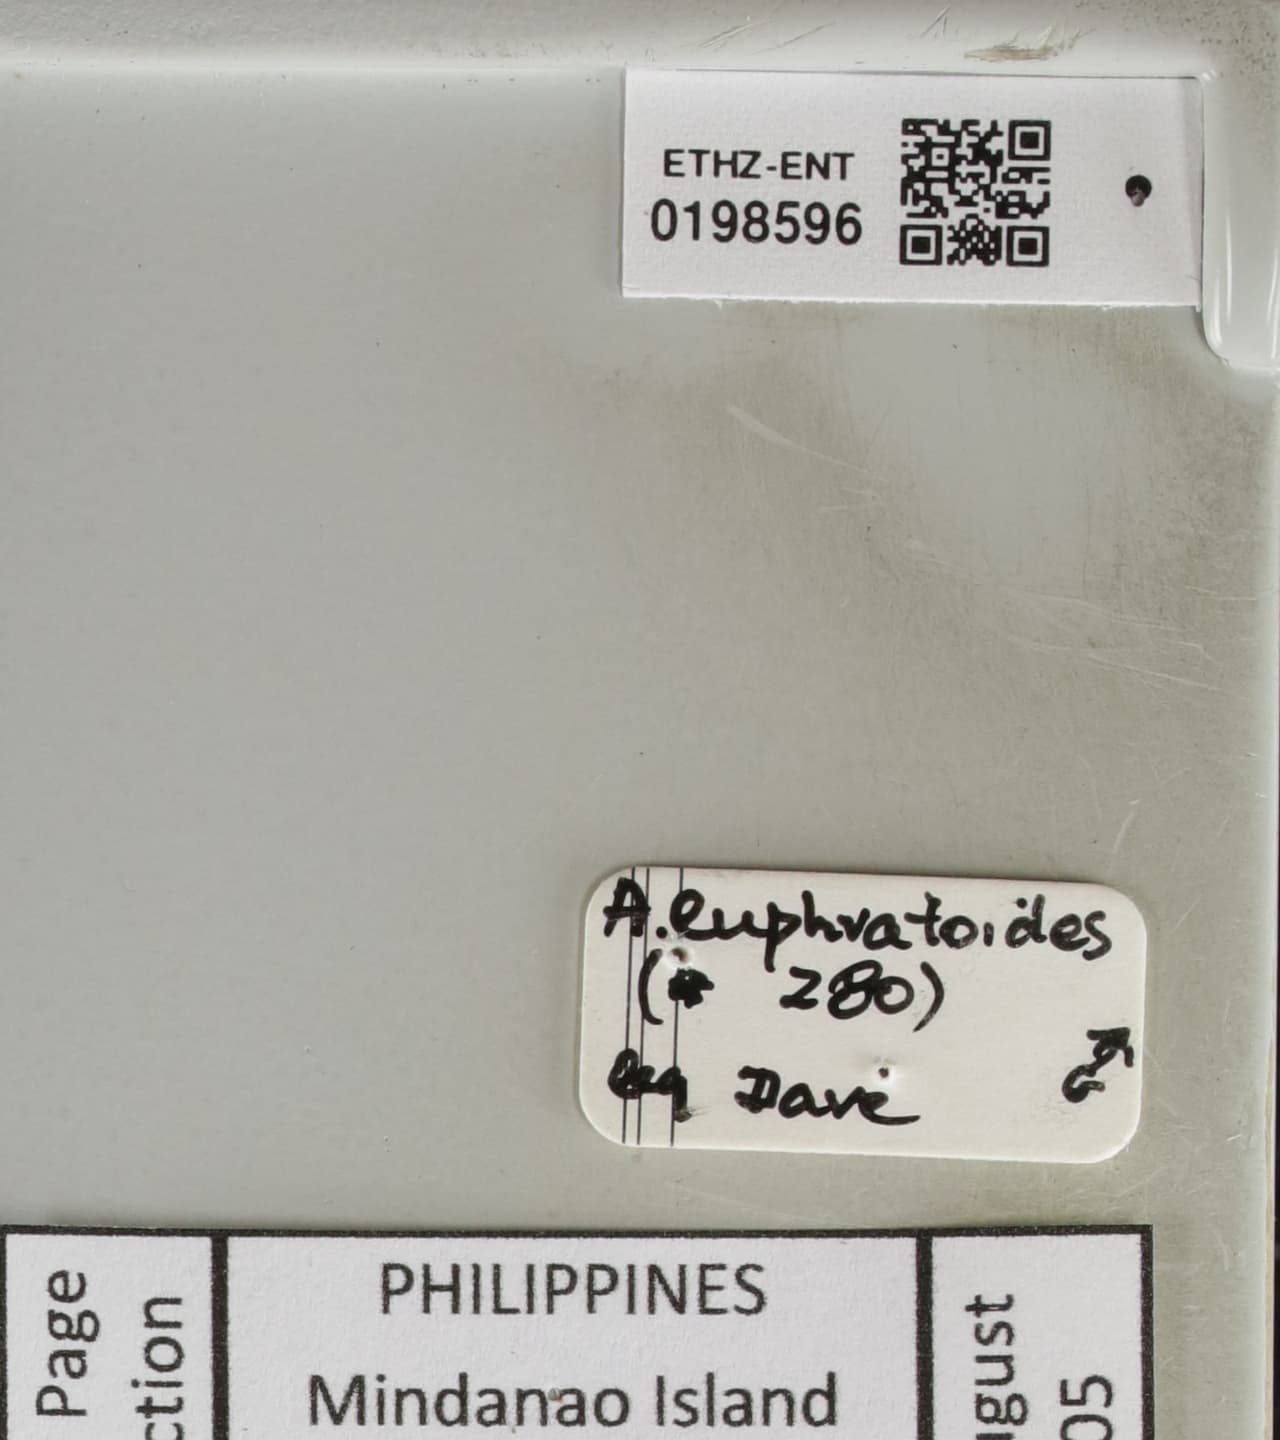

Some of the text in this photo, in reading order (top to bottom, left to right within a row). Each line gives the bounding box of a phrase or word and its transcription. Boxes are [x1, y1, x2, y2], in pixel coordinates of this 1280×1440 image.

[664, 149, 855, 180] ETHZ-ENT
[651, 198, 862, 246] 0198596
[381, 1262, 767, 1316] PHILIPPINES
[36, 1270, 100, 1416] Page
[309, 1371, 837, 1428] Mindanao Island
